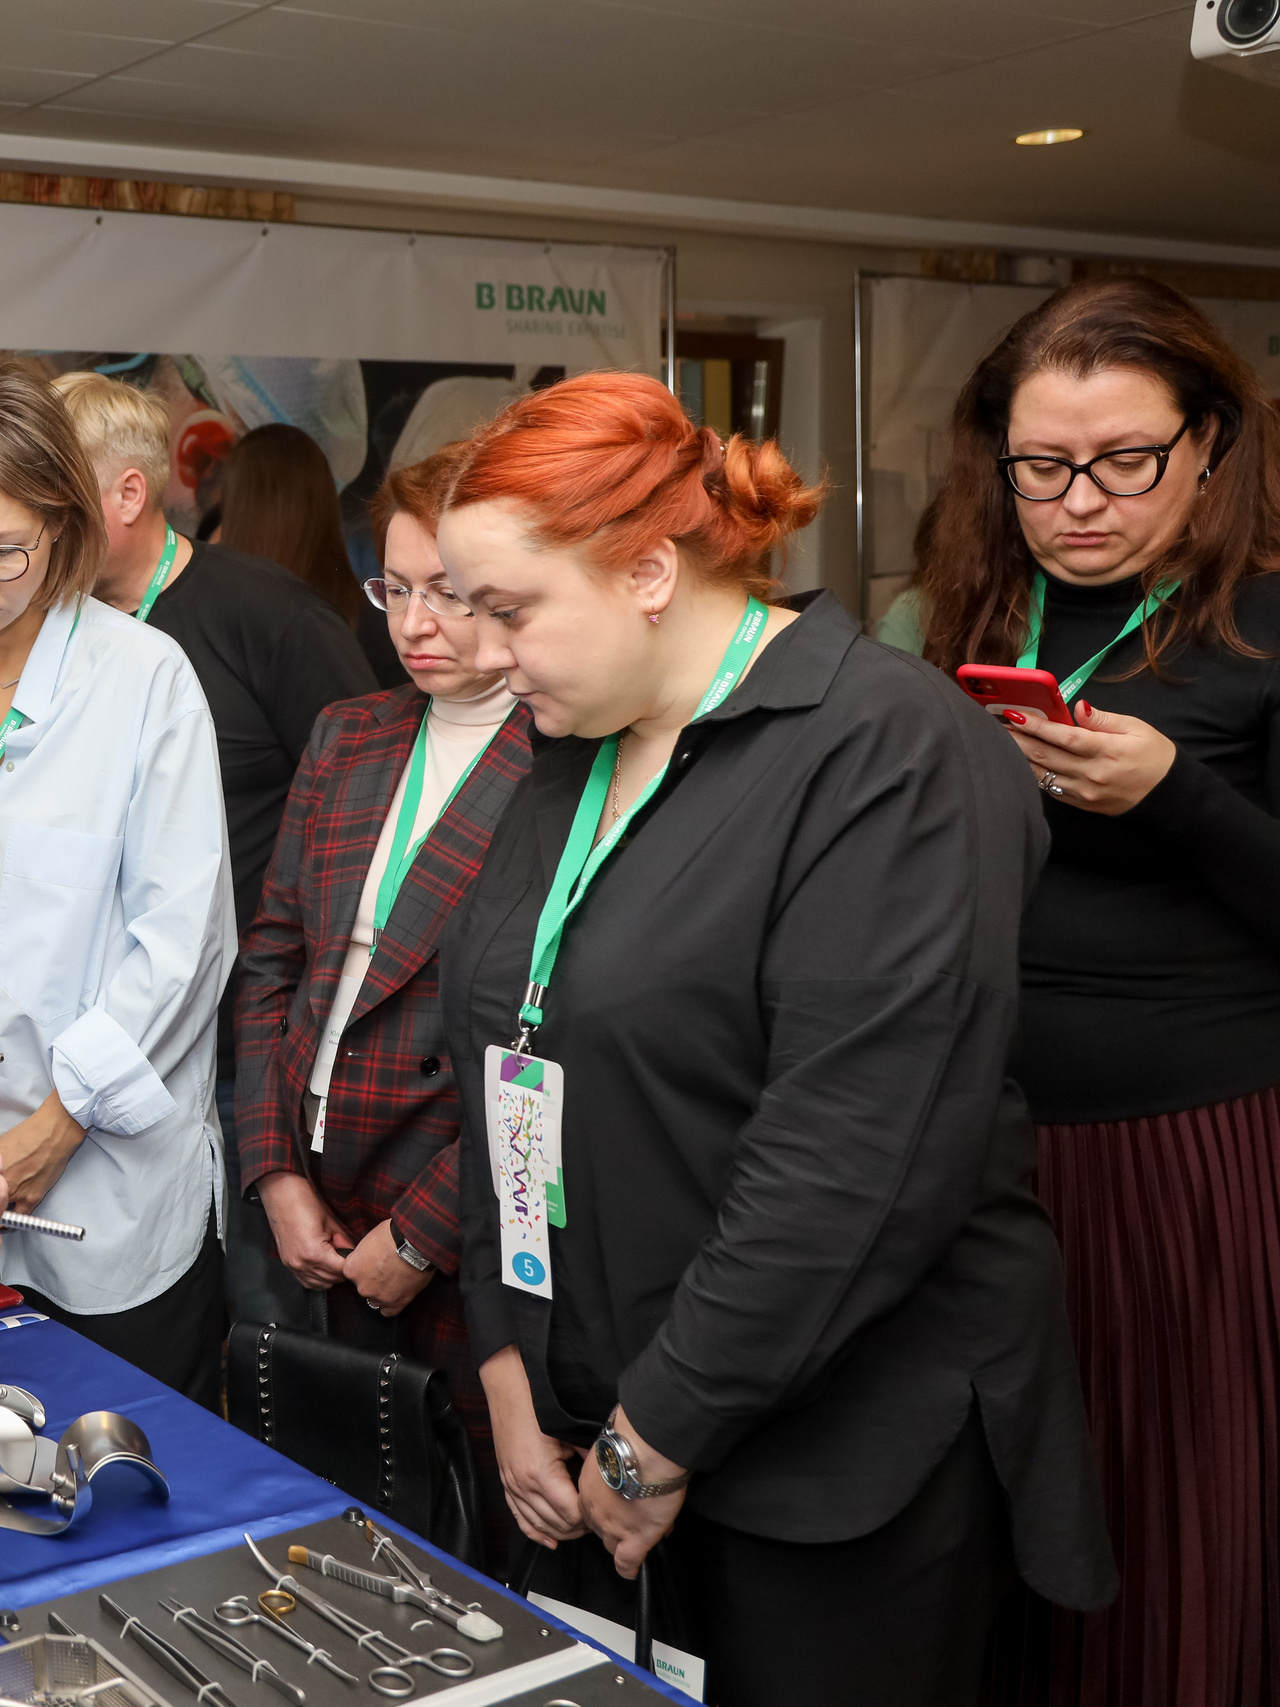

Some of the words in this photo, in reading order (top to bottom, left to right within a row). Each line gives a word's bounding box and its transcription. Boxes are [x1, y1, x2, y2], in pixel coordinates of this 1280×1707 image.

[476, 283, 495, 310] B
[506, 284, 606, 316] BRAUN
[743, 616, 762, 643] BRAUN
[704, 681, 730, 712] BRAUN
[524, 1258, 534, 1277] 5
[656, 1659, 685, 1678] BRAUN
